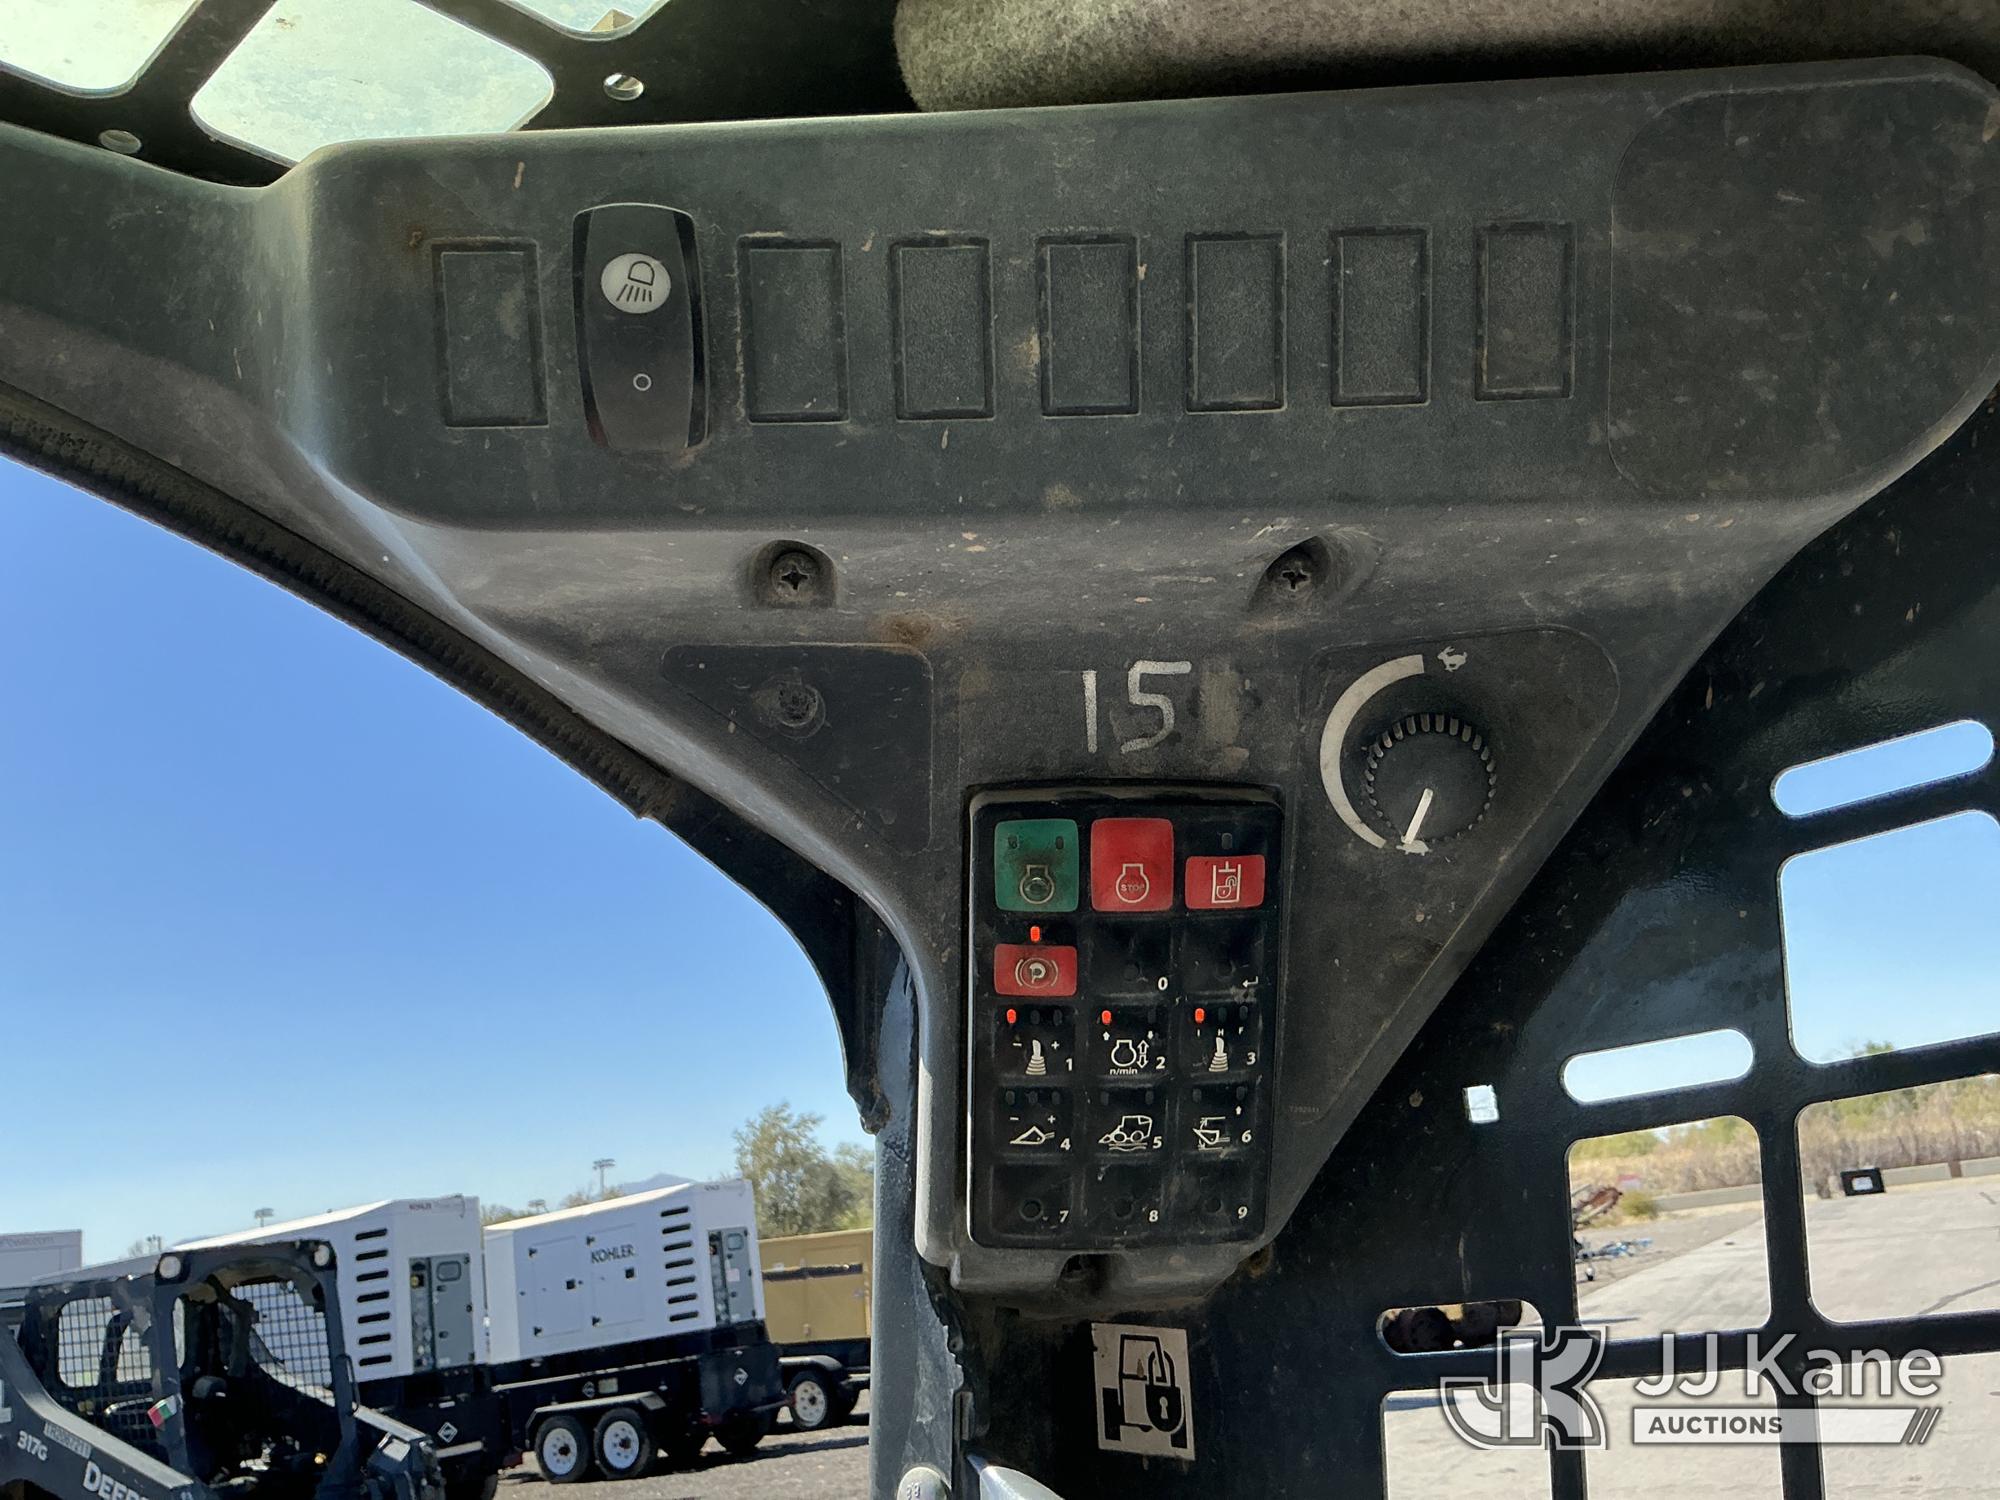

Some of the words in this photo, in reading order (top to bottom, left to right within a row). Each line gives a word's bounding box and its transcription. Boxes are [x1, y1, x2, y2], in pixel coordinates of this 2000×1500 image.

[1081, 659, 1192, 754] 15
[1121, 883, 1145, 894] STOP
[1157, 976, 1169, 991] 0
[1065, 1058, 1073, 1072] 1
[1155, 1056, 1166, 1070] 2
[1246, 1052, 1256, 1066] 3
[1109, 1067, 1139, 1076] n/min
[1152, 1135, 1163, 1149] 5
[1241, 1129, 1252, 1143] 6
[1060, 1138, 1071, 1151] 4
[1059, 1210, 1070, 1223] 7
[1148, 1209, 1159, 1223] 8
[1237, 1206, 1248, 1220] 9
[591, 1243, 635, 1264] KOHLER
[17, 1430, 49, 1461] 317G
[83, 1460, 149, 1500] DEER
